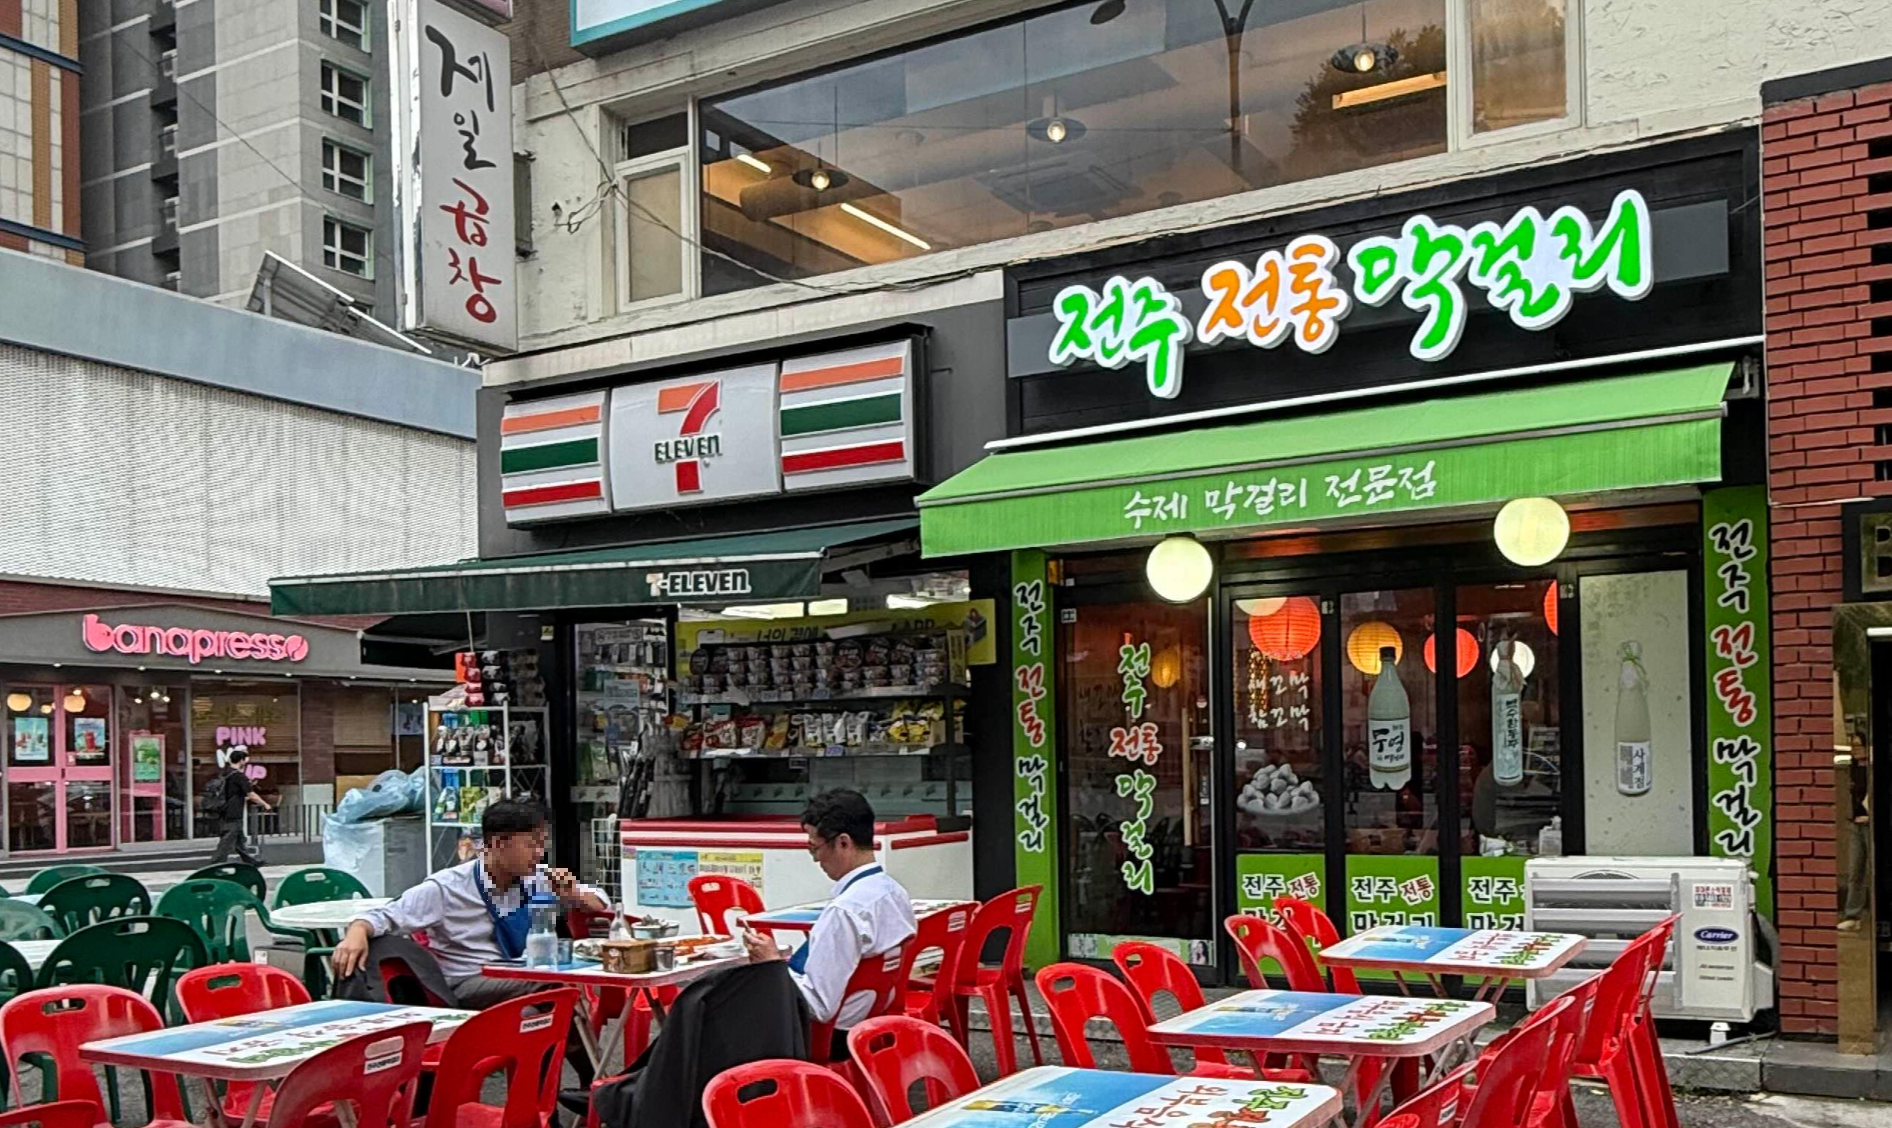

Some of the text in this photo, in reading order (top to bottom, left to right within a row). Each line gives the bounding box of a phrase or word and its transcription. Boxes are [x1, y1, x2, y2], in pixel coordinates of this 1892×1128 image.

[1050, 190, 1653, 398] 전주 전통 막걸리
[1124, 460, 1437, 529] 수제 막걸리 전문점
[1709, 520, 1757, 613] 전주
[83, 613, 309, 664] banapresso
[1711, 621, 1759, 727] 전통
[215, 726, 267, 746] PINK
[1014, 579, 1049, 852] 전주 전통 막걸리
[1108, 642, 1163, 895] 전주 전통 막걸리
[1713, 735, 1762, 856] 막걸리
[1242, 871, 1322, 900] 전주 전통
[1351, 874, 1435, 906] 전주 전통
[1468, 877, 1518, 904] 전주
[1700, 930, 1735, 940] Carrier
